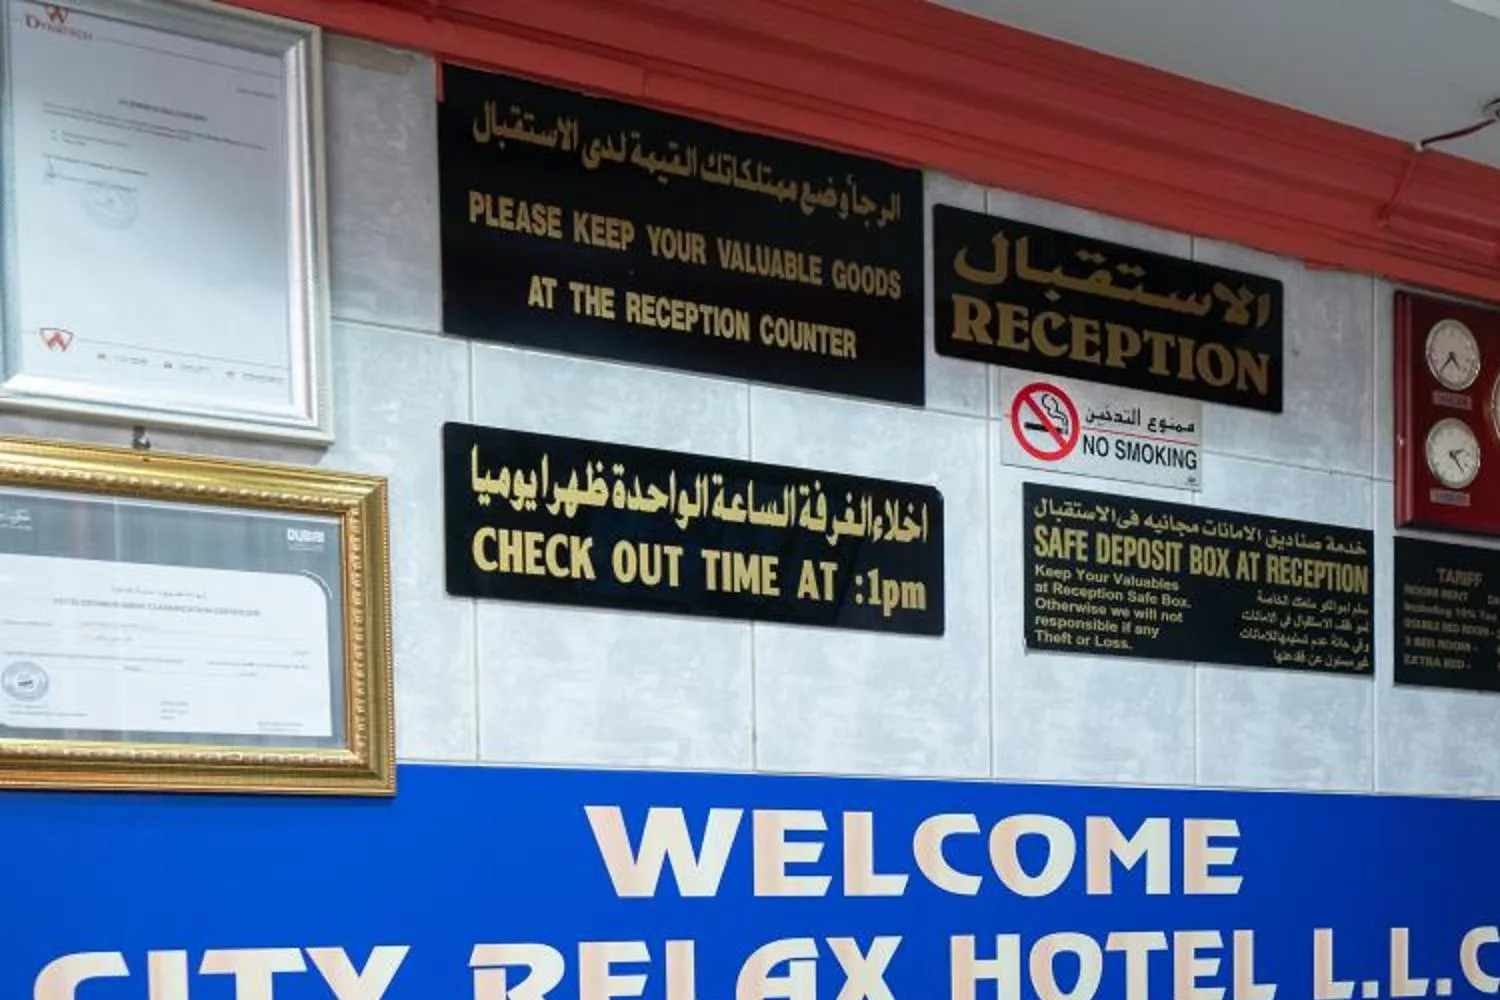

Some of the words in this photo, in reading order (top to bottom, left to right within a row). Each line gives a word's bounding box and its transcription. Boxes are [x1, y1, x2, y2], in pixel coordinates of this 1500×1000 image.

[473, 100, 578, 152] الاستقبال
[630, 131, 698, 185] القيمة
[469, 191, 562, 239] PLEASE
[573, 210, 635, 251] KEEP
[647, 226, 707, 265] YOUR
[718, 238, 822, 286] VALUABLE
[831, 260, 901, 299] GOODS
[953, 229, 1271, 329] الاستقبال
[528, 275, 559, 309] AT
[570, 282, 615, 321] THE
[626, 291, 750, 342] RECEPTION
[760, 315, 857, 360] COUNTER
[951, 293, 1270, 396] RECEPTION
[1085, 407, 1141, 427] التدخين
[1147, 416, 1195, 433] ممنوع
[471, 443, 538, 511] يوميا
[1083, 433, 1109, 457] NO
[1115, 439, 1197, 470] SMOKING
[612, 463, 709, 530] الواحدة
[712, 472, 796, 528] الساعة
[799, 480, 872, 546] الغرفة
[1033, 497, 1117, 523] الاستقبال
[472, 526, 596, 580] CHECK
[612, 539, 683, 588] OUT
[701, 548, 780, 597] TIME
[798, 559, 838, 601] AT
[1033, 525, 1089, 562] SAFE
[1095, 531, 1183, 573] DEPOSIT
[1189, 544, 1231, 580] BOX
[1235, 550, 1261, 583] AT
[1266, 553, 1369, 596] RECEPTION
[1034, 563, 1073, 581] Keep
[1075, 568, 1110, 583] Your
[1113, 572, 1180, 591] Valuables
[1034, 581, 1049, 593] at
[1053, 583, 1124, 600] Reception
[1127, 590, 1158, 604] Safe
[1034, 597, 1107, 616] Otherwise
[1110, 607, 1131, 618] we
[1134, 608, 1158, 621] will
[1161, 611, 1184, 623] not
[1034, 614, 1118, 633] responsible
[1134, 625, 1160, 639] any
[1034, 629, 1073, 645] Theft
[1075, 636, 1091, 647] or
[584, 804, 1244, 898] WELCOME
